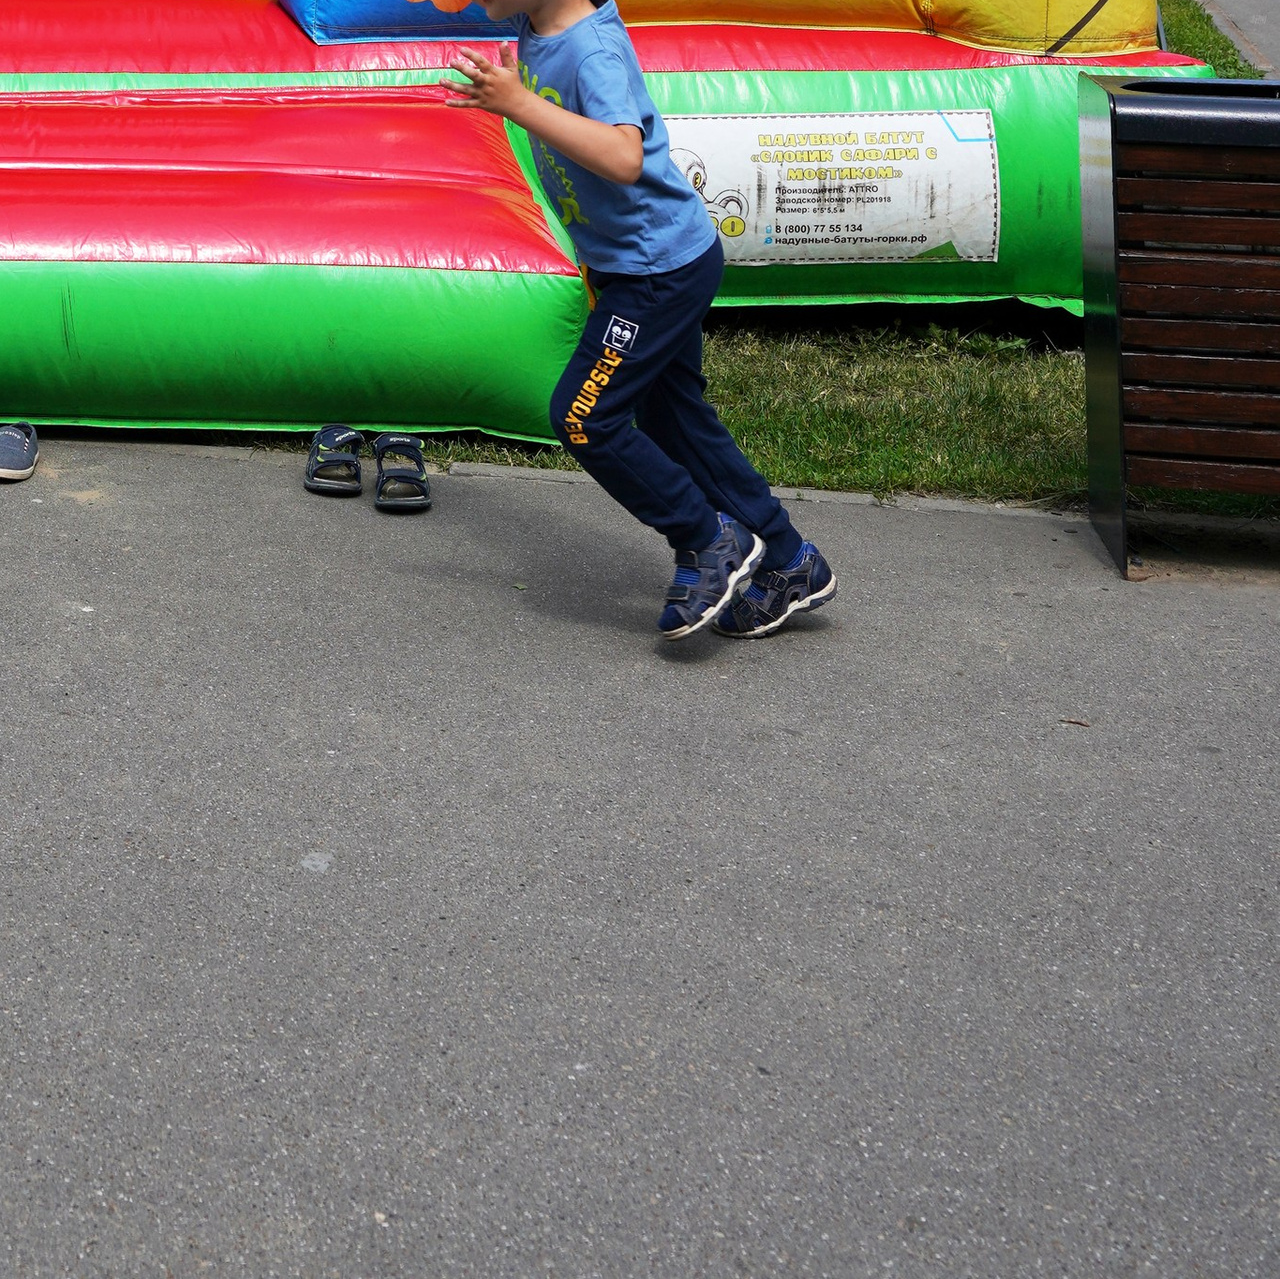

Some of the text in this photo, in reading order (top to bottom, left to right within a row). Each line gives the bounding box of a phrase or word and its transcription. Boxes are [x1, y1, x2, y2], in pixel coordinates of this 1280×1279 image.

[757, 131, 924, 147] НАДУВНОЙ БАТУТ
[840, 148, 920, 162] САФАРИ
[925, 147, 938, 160] С
[786, 166, 904, 181] МОСТИКОМ»
[848, 185, 878, 193] ATTRO
[775, 197, 821, 205] Заводской
[856, 196, 892, 204] PL201918
[775, 207, 810, 215] Размер:
[775, 224, 863, 235] 8 (800) 77 55 134
[775, 234, 928, 245] надувные-батуты-горки.рф
